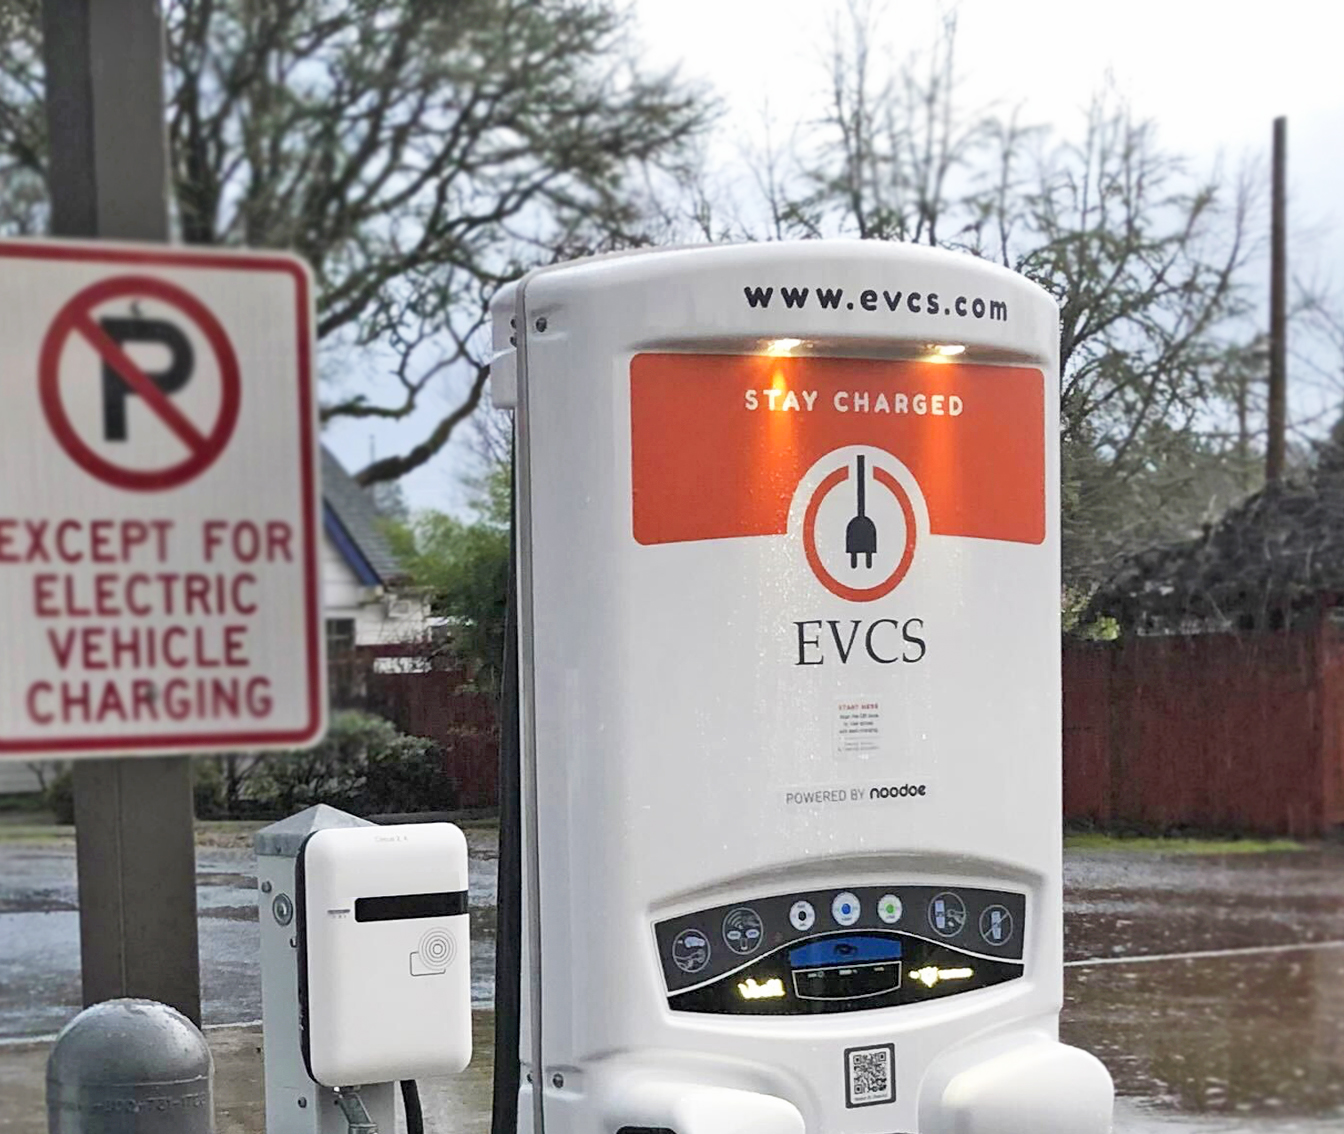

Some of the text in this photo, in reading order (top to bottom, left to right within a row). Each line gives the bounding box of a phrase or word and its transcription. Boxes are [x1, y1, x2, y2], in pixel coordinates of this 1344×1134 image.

[743, 286, 1008, 322] www.evcs.com
[744, 388, 964, 417] STAY CHARGED
[202, 520, 294, 563] FOR
[33, 572, 258, 618] ELECTRIC
[47, 624, 250, 671] VEHICLE
[792, 617, 927, 666] EVCS
[25, 676, 273, 725] CHARGING
[785, 783, 927, 805] POWERED BY noodoe
